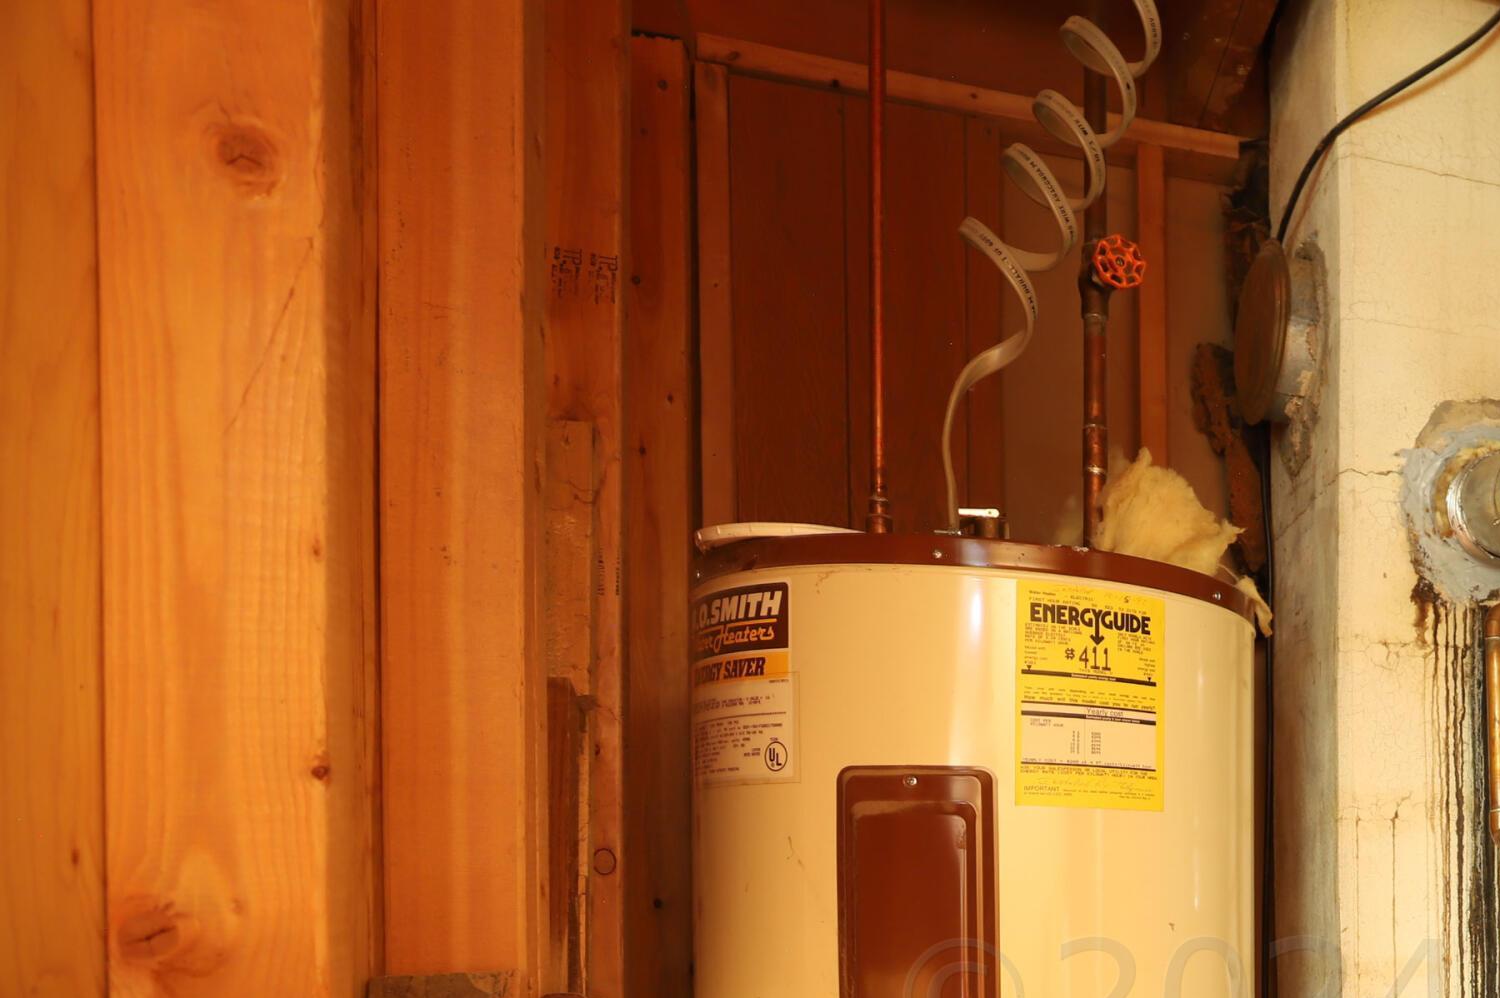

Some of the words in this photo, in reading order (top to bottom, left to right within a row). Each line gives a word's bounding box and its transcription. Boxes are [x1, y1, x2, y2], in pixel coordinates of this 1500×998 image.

[1030, 602, 1151, 636] ENERGYGUIDE
[723, 657, 766, 679] SAVER
[1086, 707, 1108, 717] Yearly
